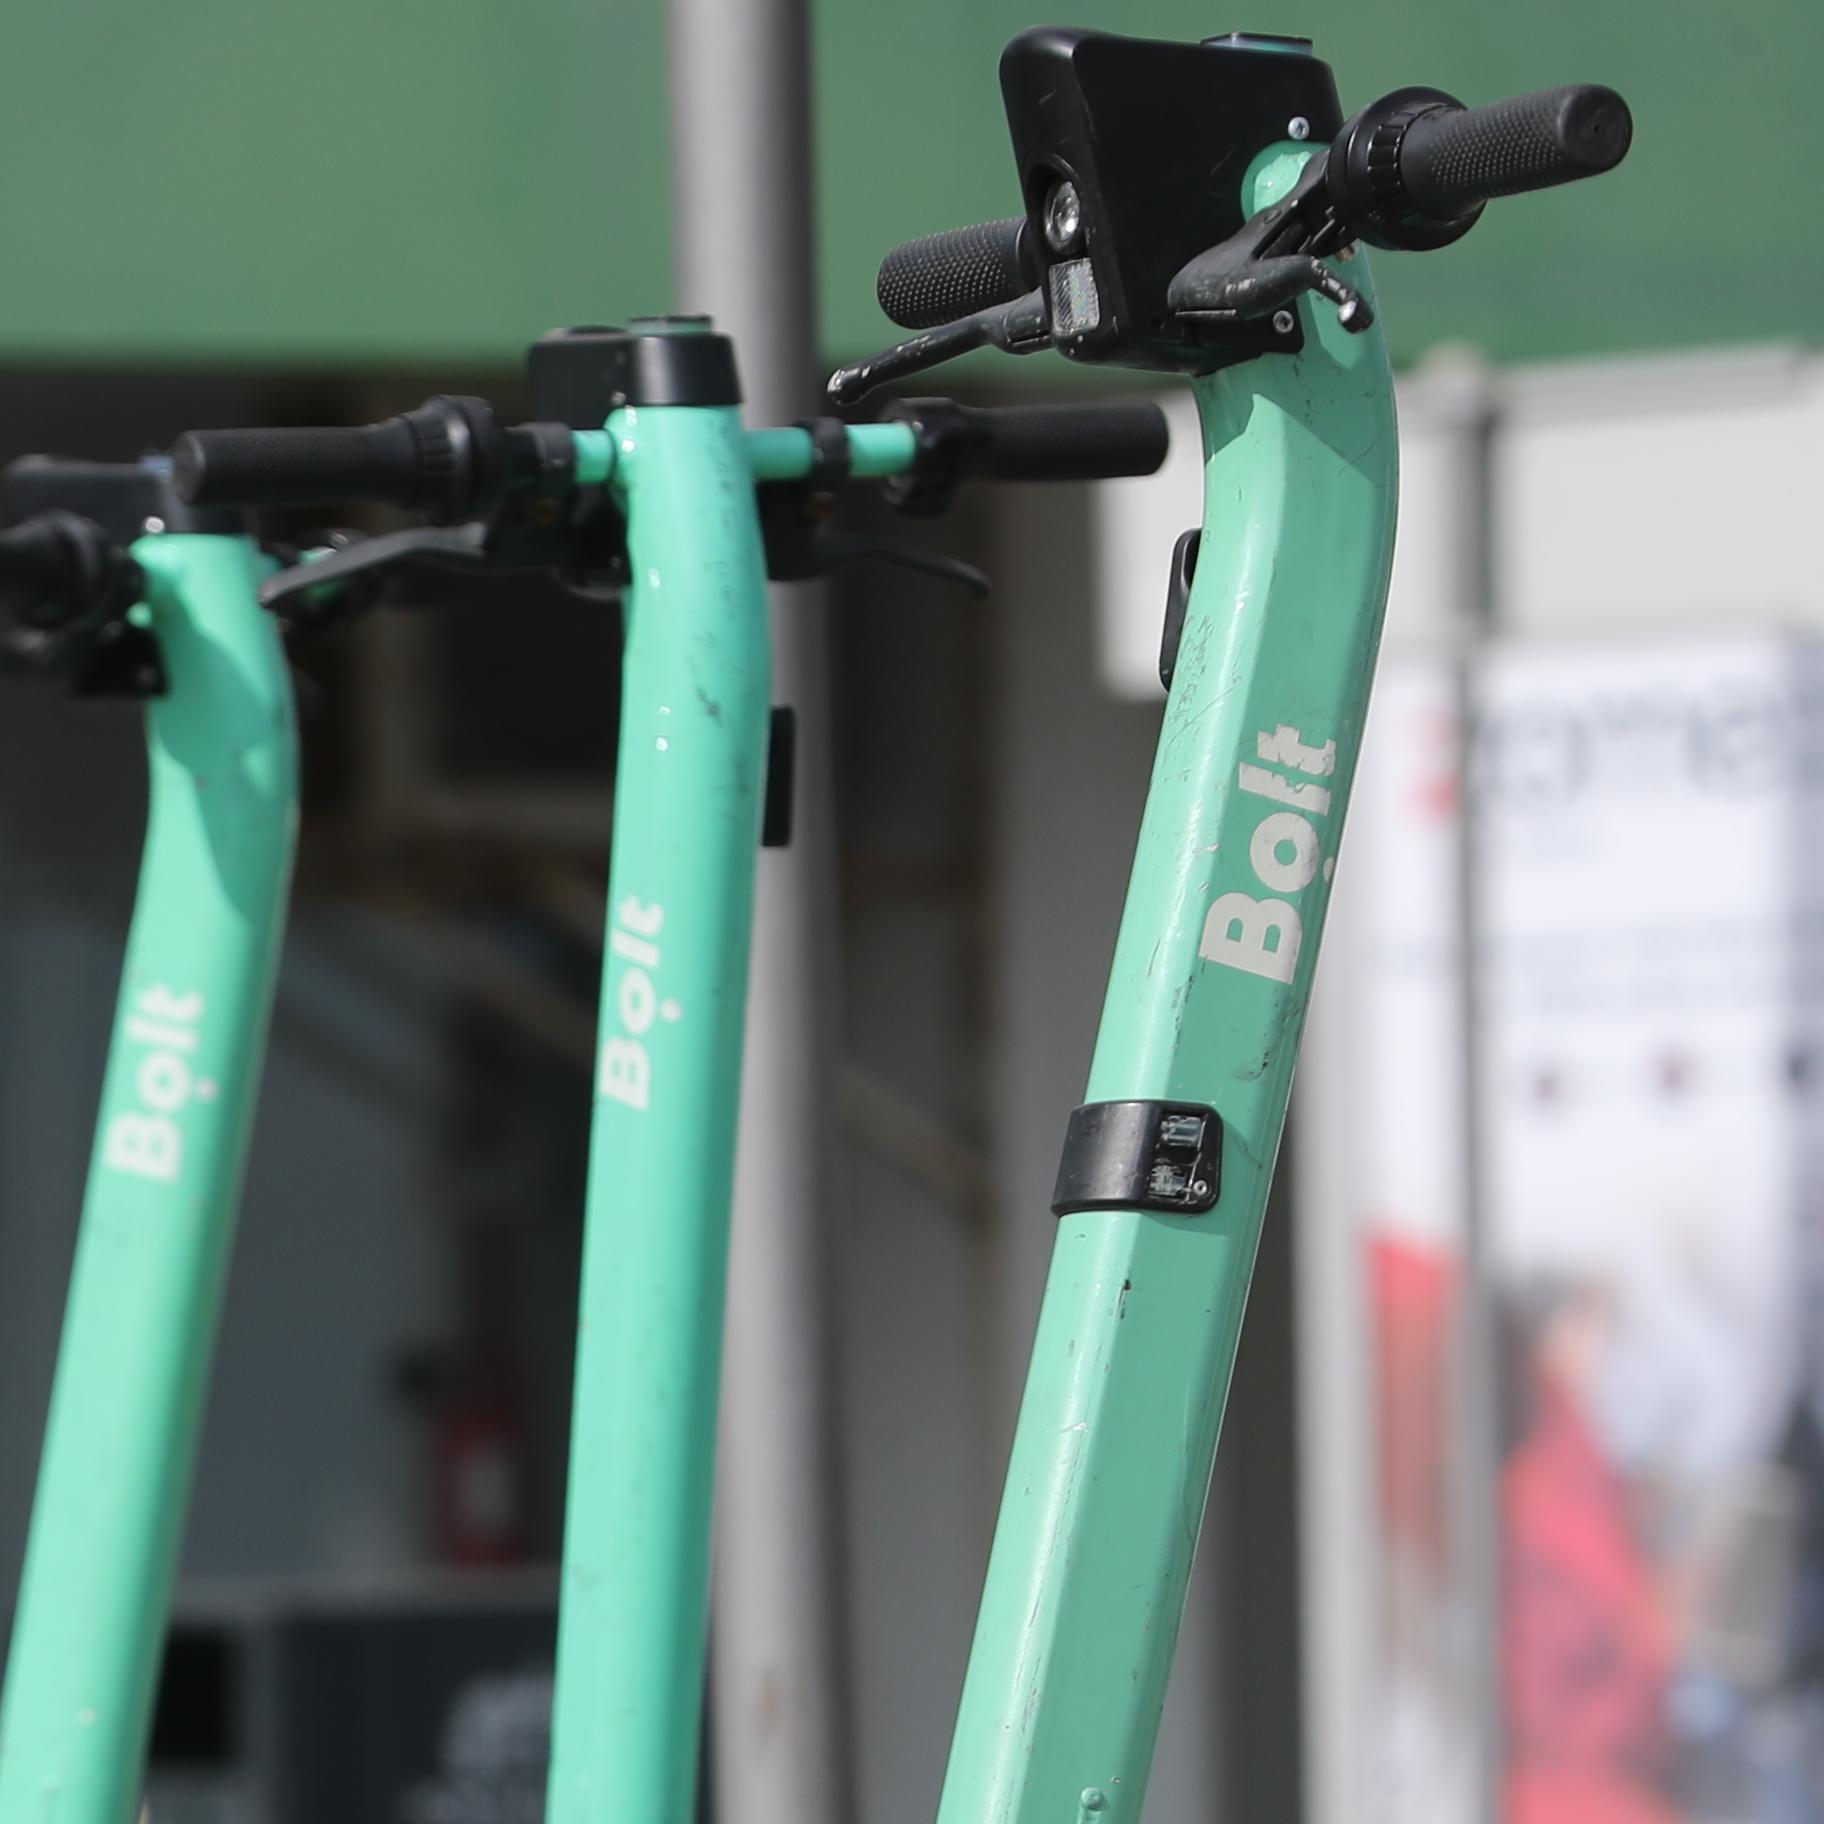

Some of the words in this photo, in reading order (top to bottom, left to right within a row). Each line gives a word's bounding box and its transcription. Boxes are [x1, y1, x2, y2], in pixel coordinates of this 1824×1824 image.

[1198, 723, 1337, 985] Bolt
[103, 980, 210, 1183] Bolt
[599, 893, 672, 1112] Bolt
